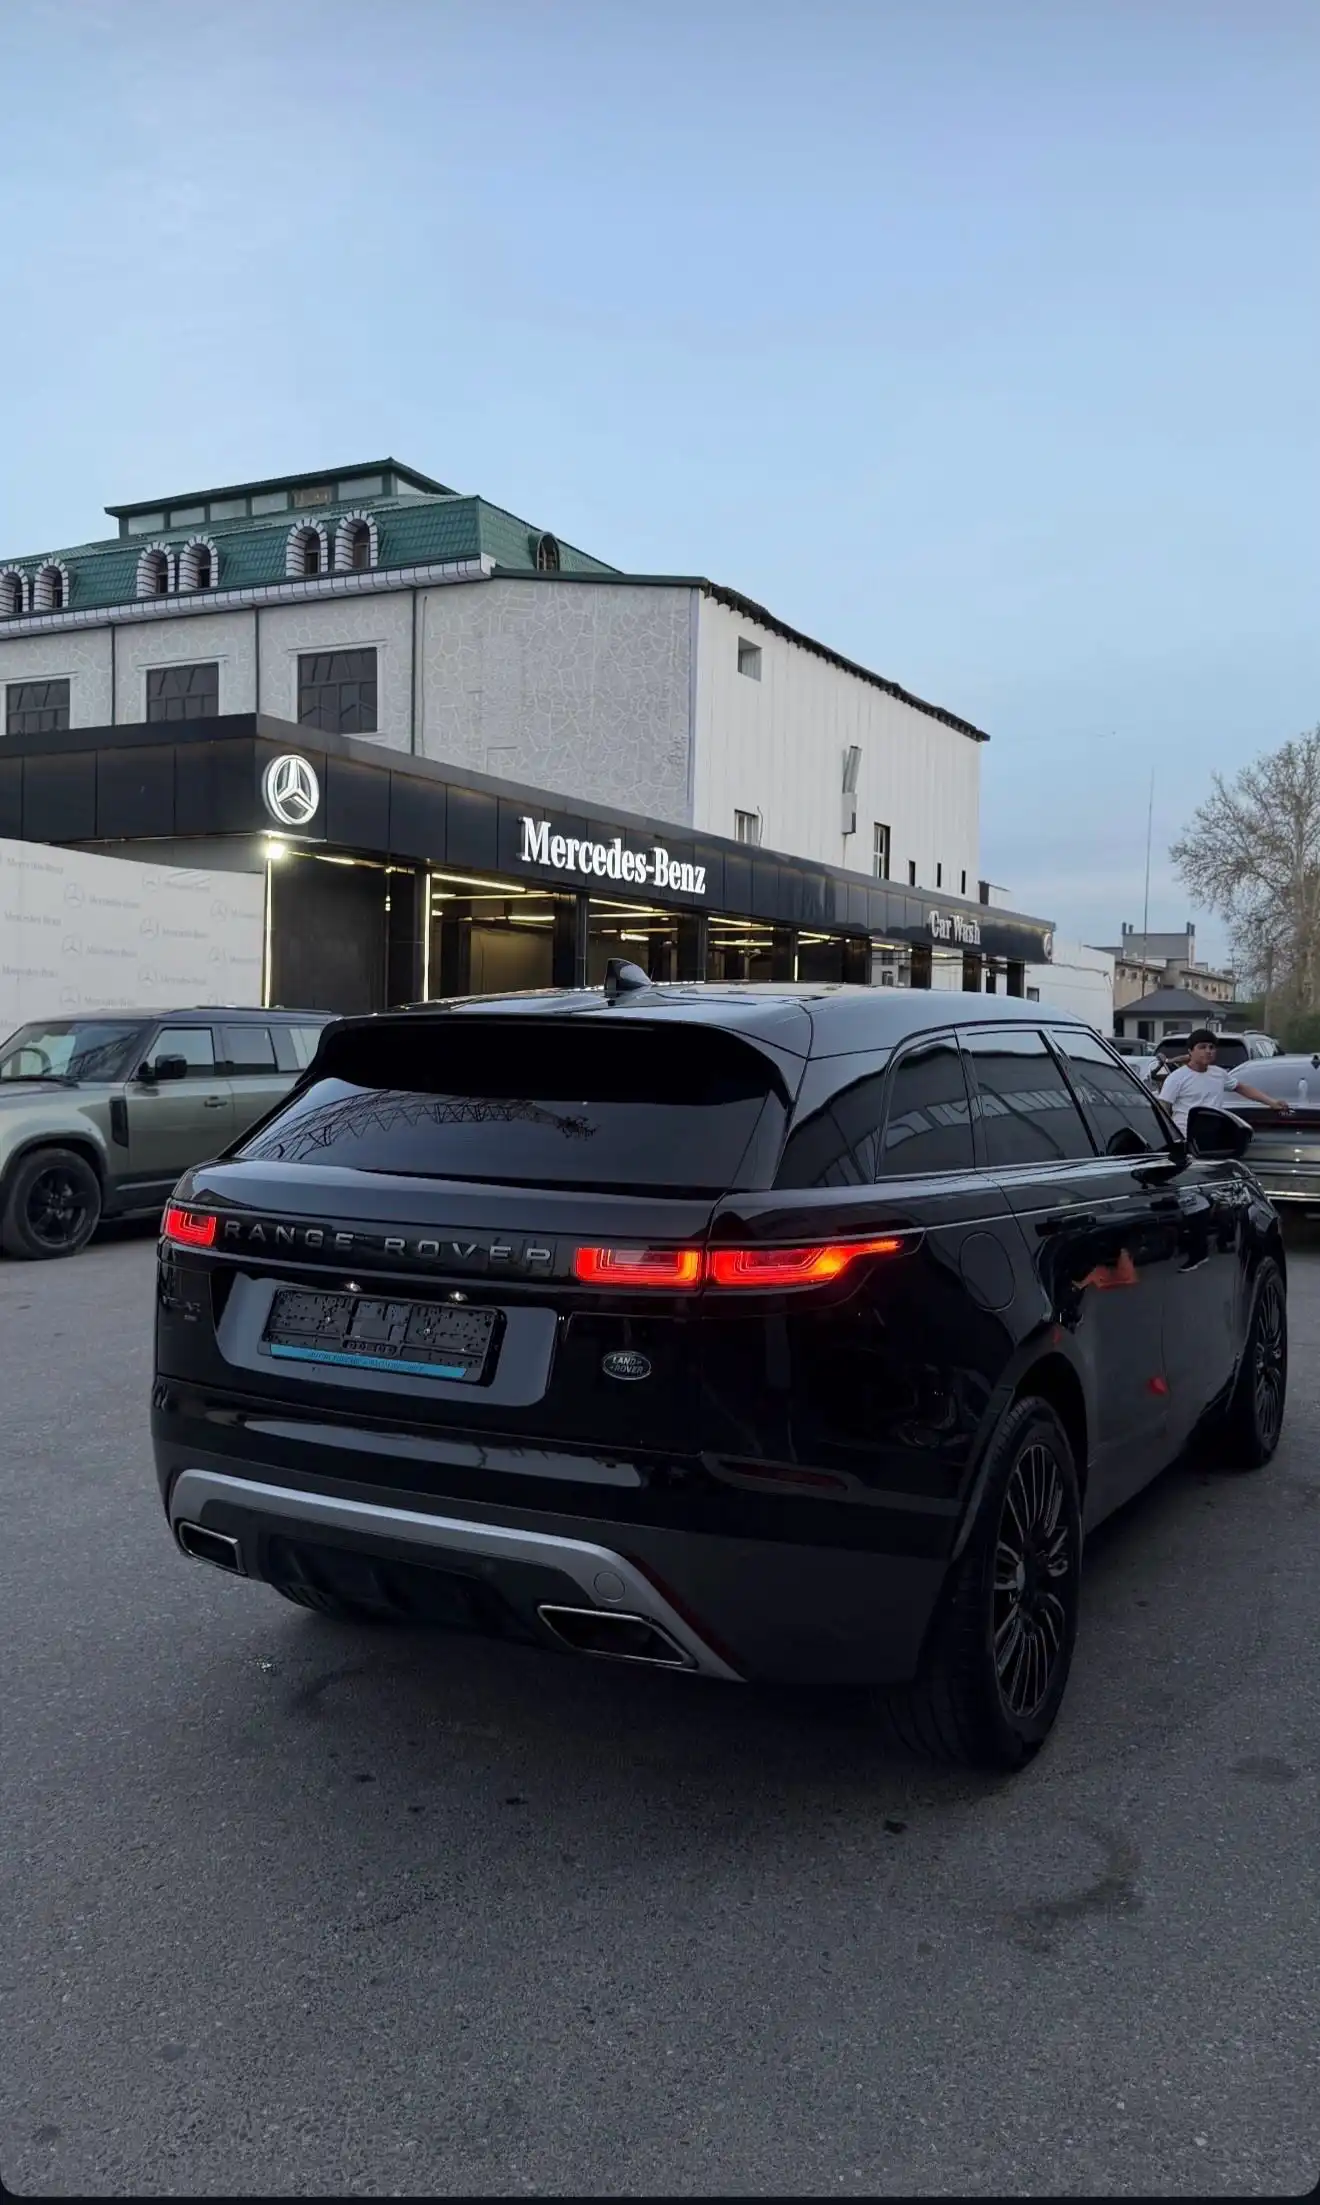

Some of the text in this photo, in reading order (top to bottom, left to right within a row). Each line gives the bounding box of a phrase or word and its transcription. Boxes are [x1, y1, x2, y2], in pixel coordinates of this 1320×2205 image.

[521, 816, 706, 894] Mercedes-Benz
[931, 910, 981, 945] Car Wash
[223, 1220, 552, 1265] RANGE ROVER
[612, 1357, 637, 1366] LAND
[614, 1364, 644, 1376] ROVER
